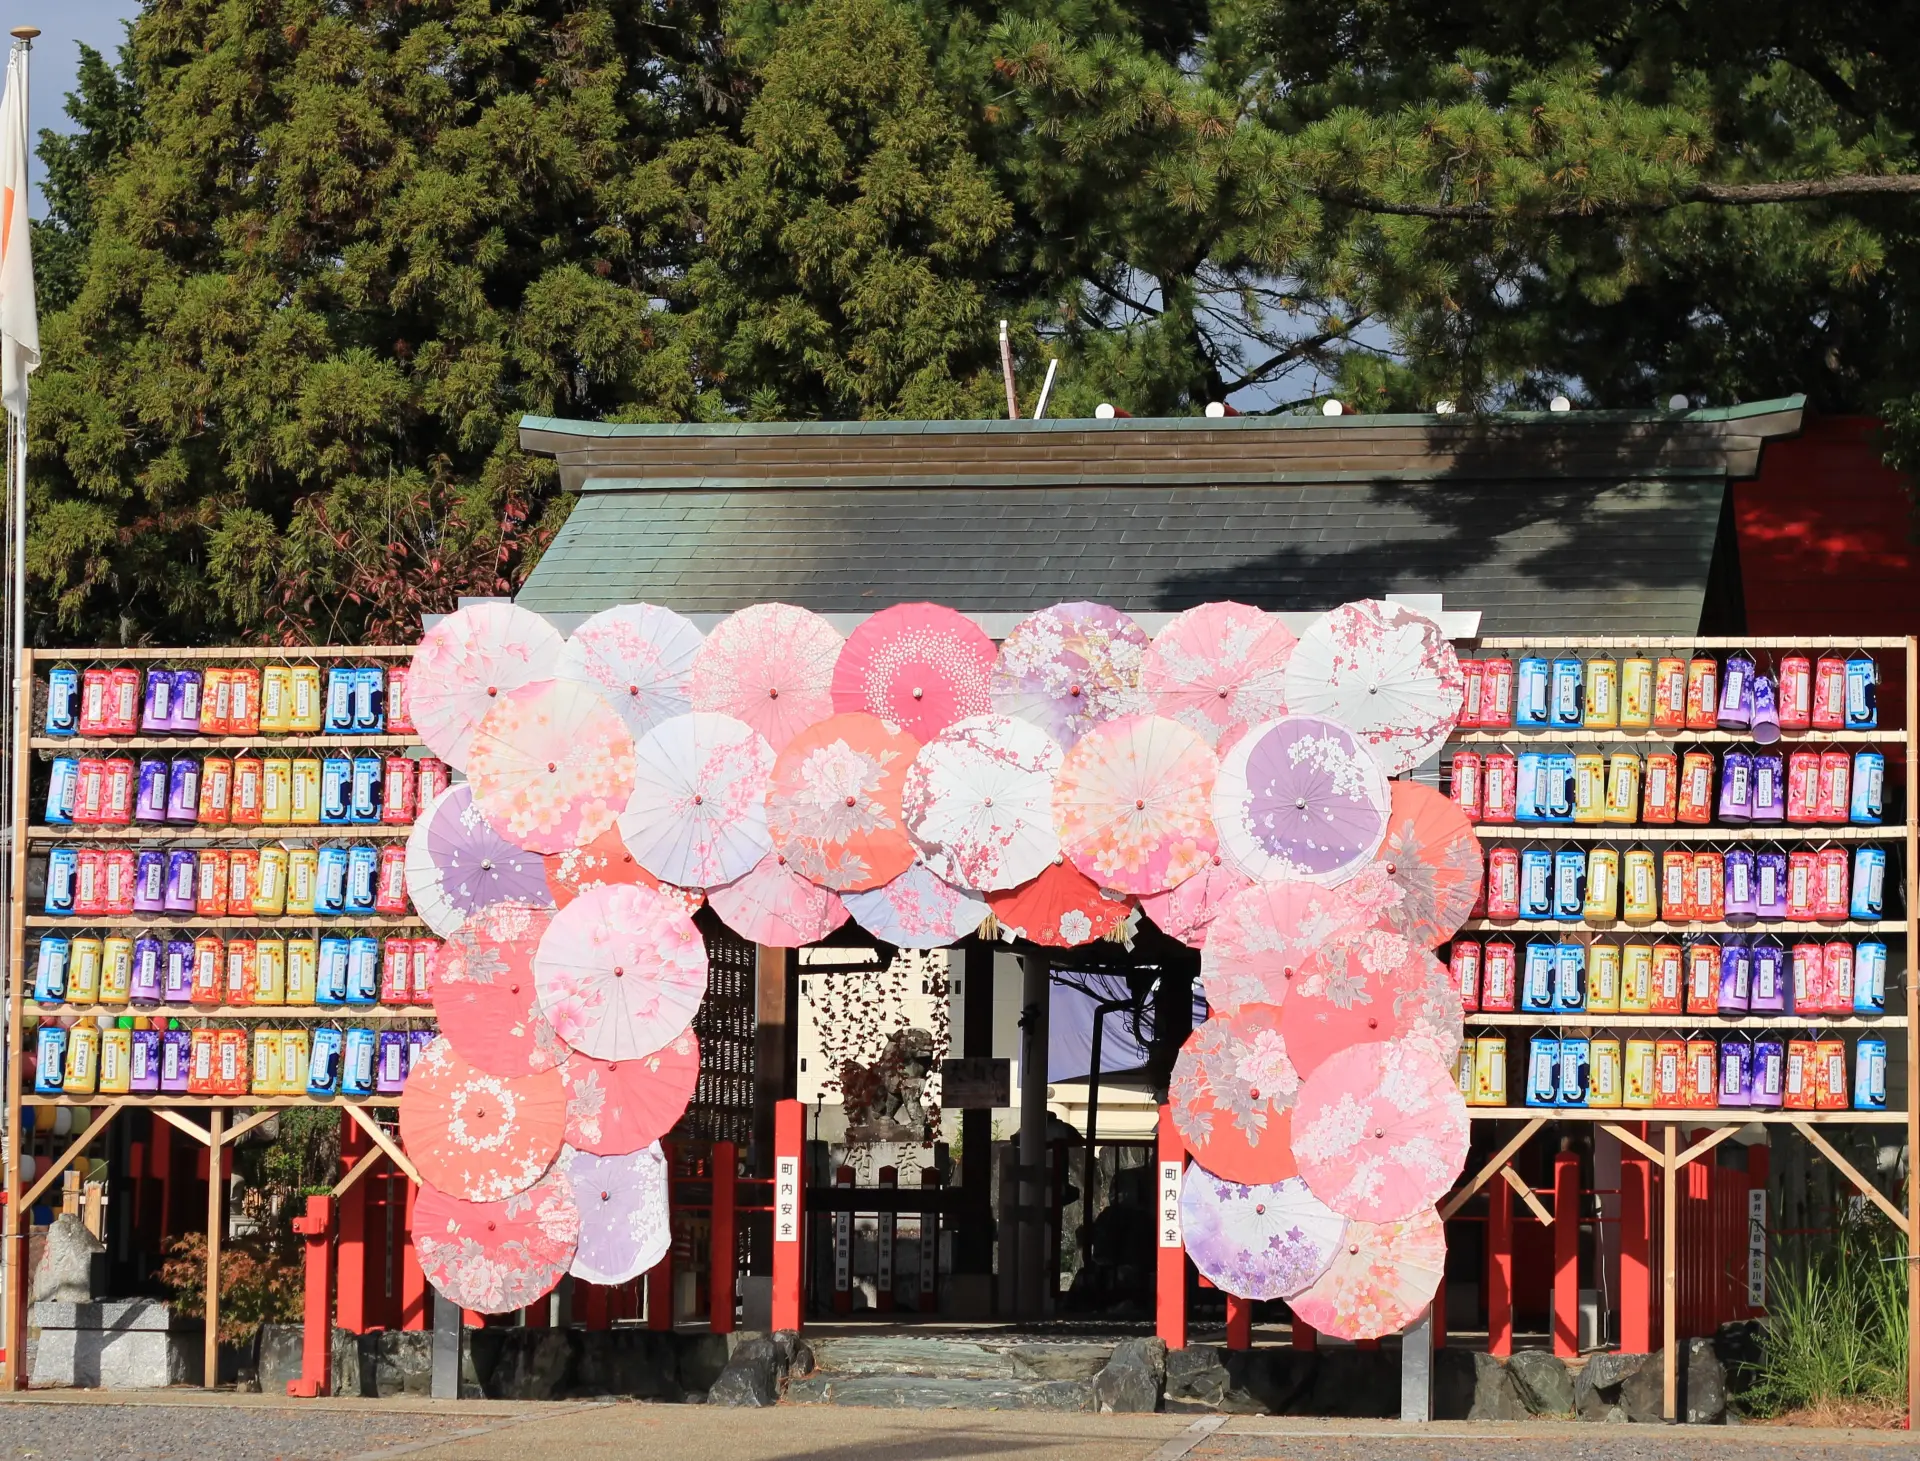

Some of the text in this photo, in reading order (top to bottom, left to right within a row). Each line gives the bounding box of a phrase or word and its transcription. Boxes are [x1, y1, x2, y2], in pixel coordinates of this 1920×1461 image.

[780, 1163, 793, 1236] 町内安全
[1164, 1168, 1177, 1242] 町内安全
